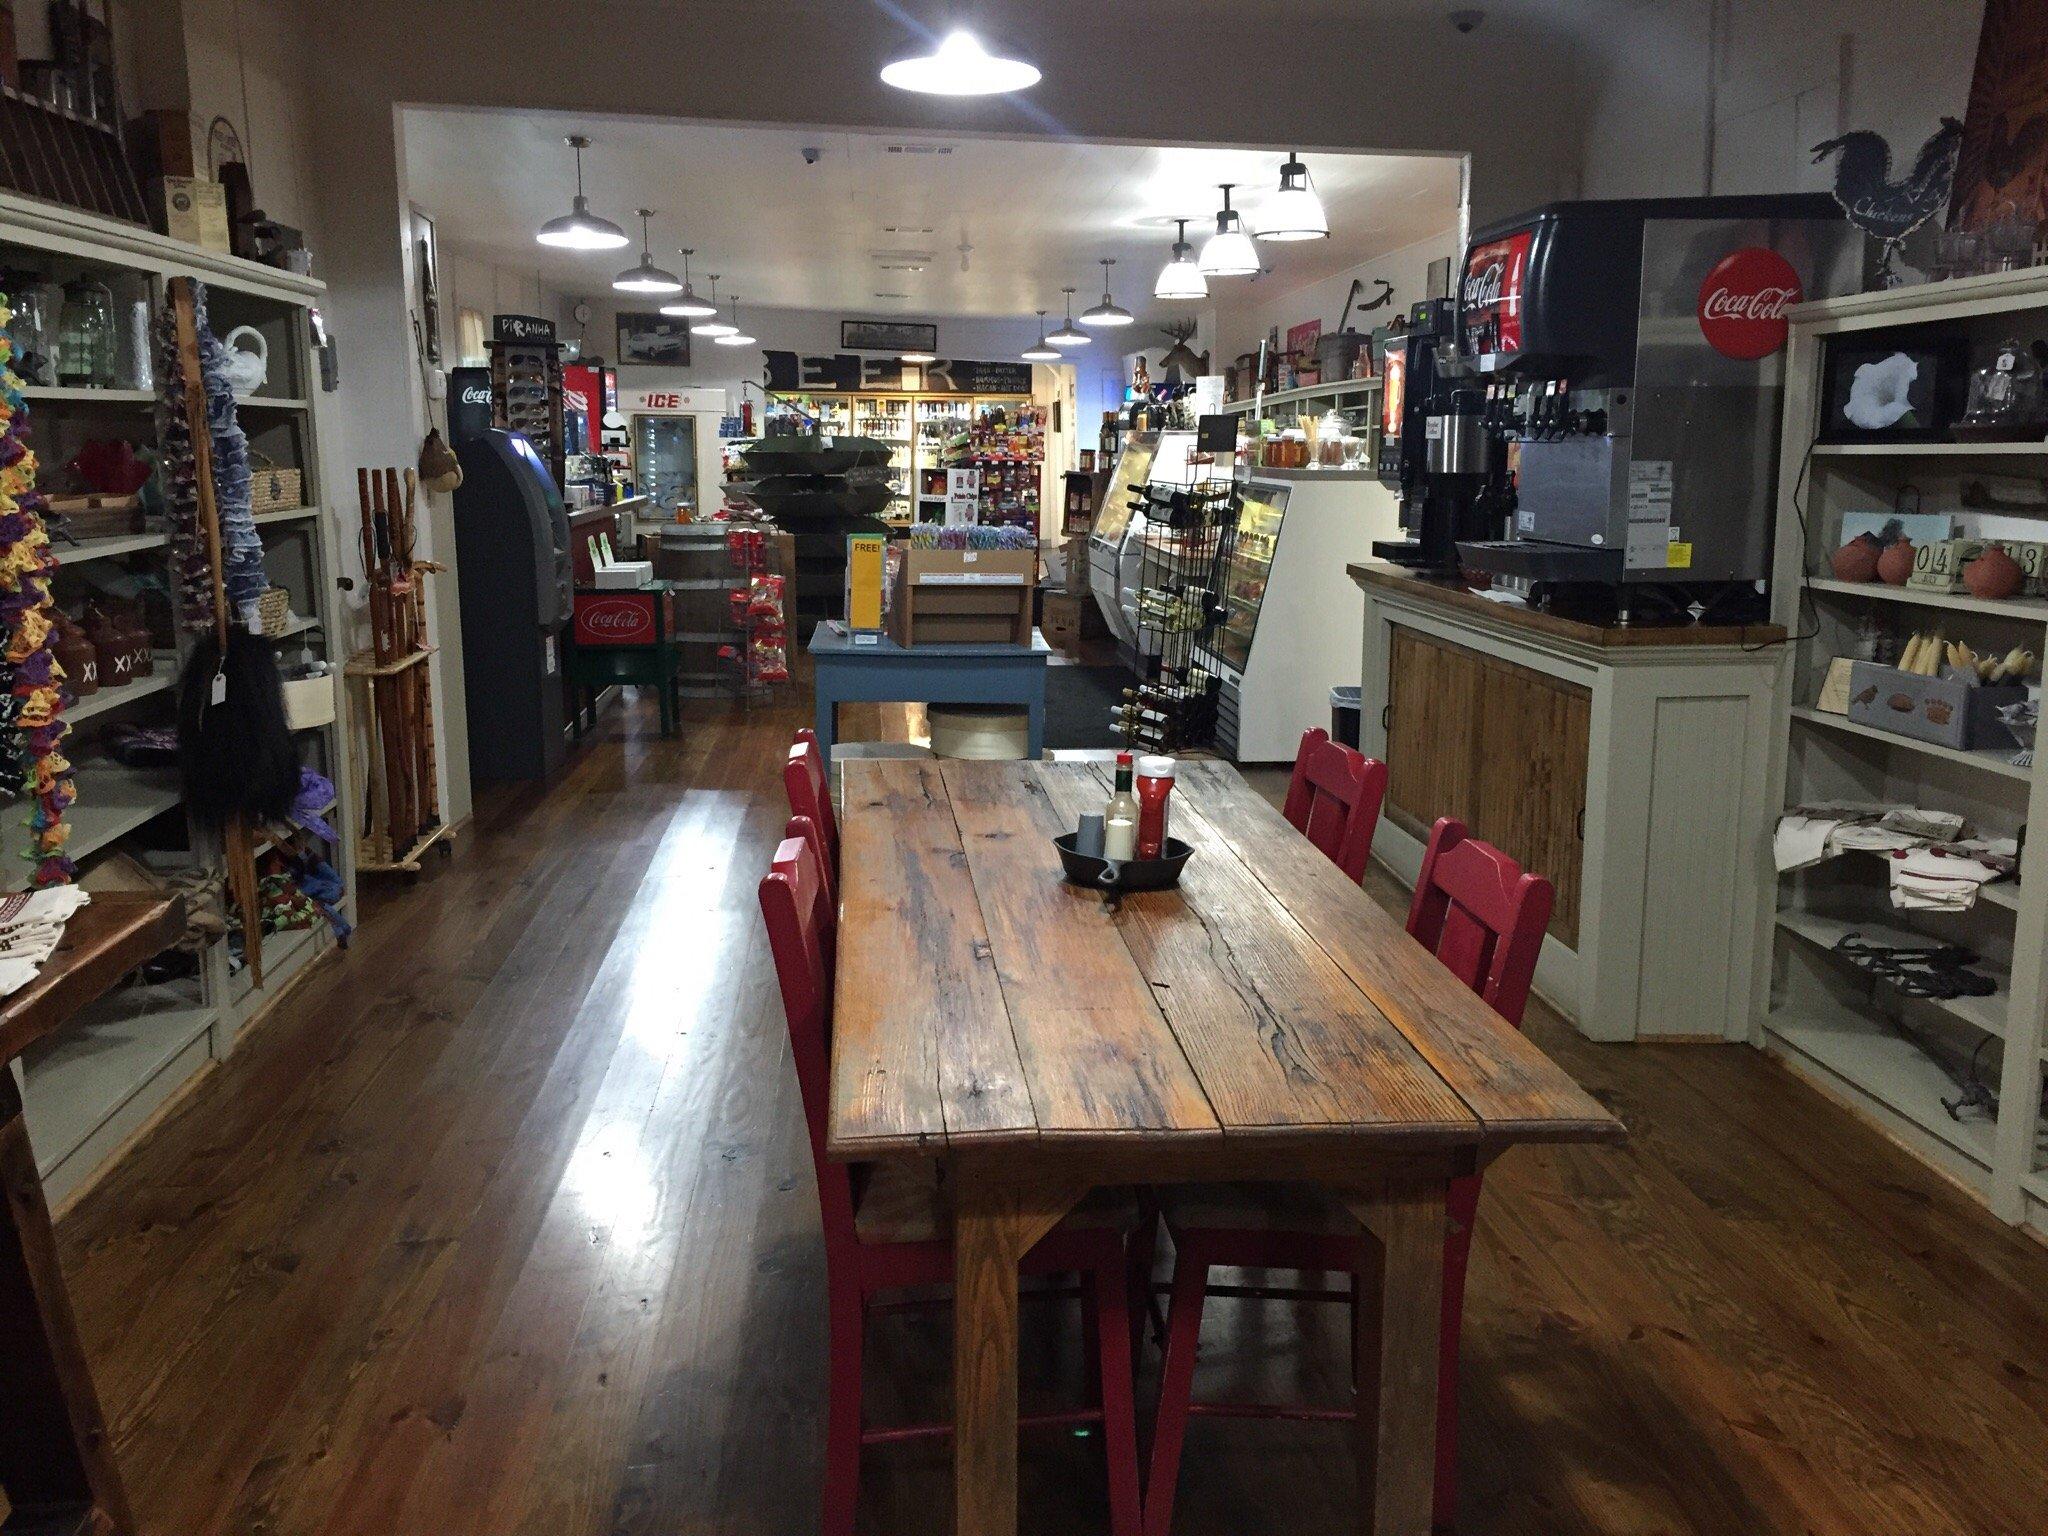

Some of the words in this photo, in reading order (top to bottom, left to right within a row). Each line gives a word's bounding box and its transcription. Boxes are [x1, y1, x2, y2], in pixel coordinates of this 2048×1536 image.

[461, 386, 493, 405] Coca-C
[647, 393, 680, 408] ICE
[854, 542, 880, 553] FREE!
[589, 610, 639, 627] Coca-Cola
